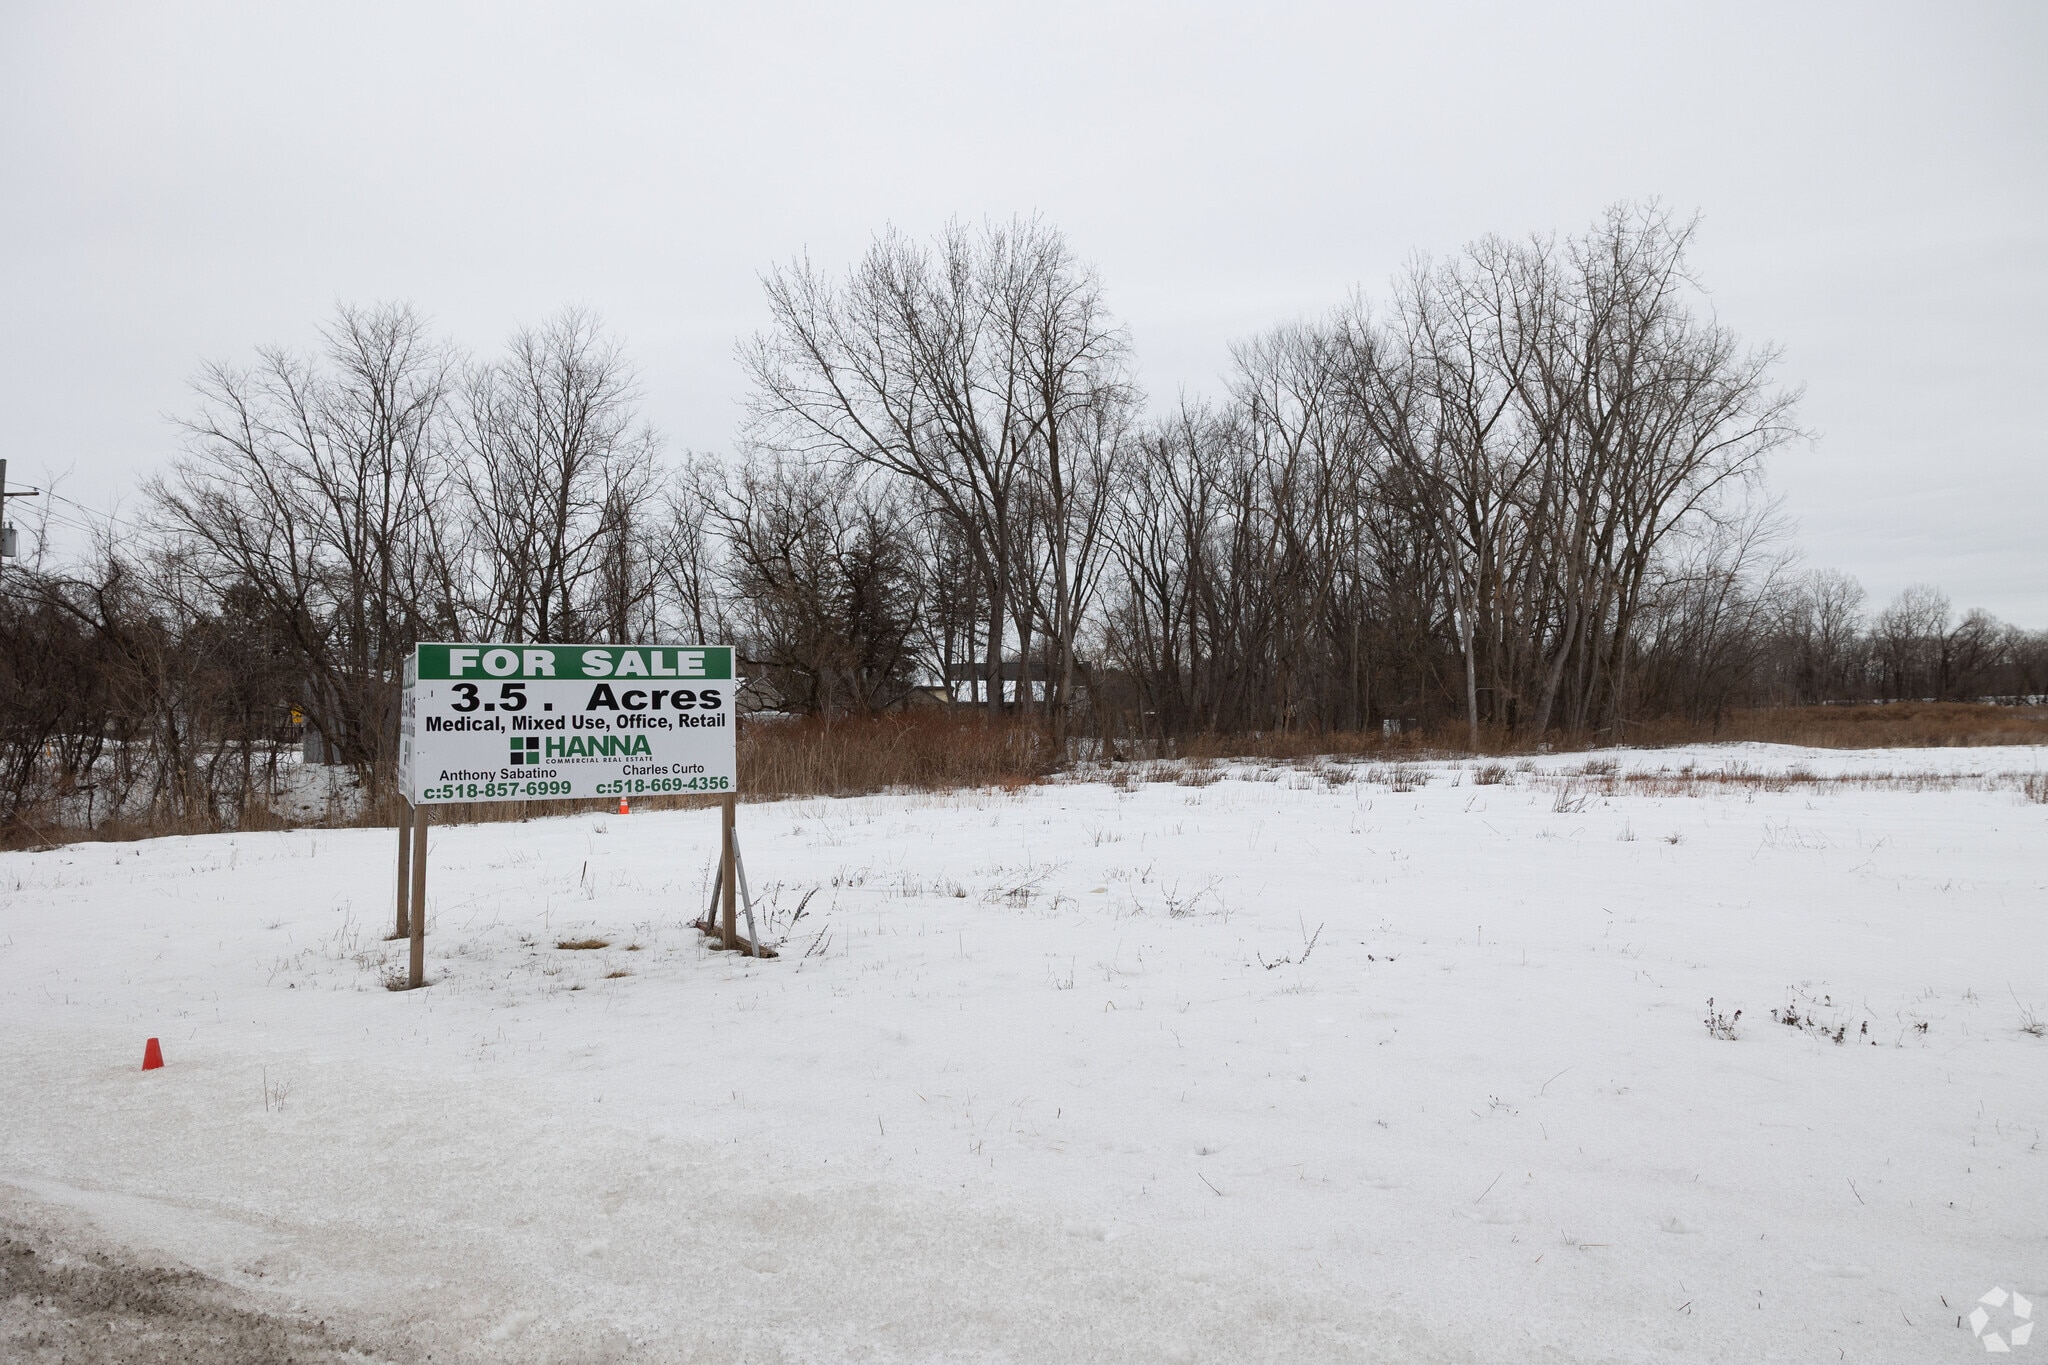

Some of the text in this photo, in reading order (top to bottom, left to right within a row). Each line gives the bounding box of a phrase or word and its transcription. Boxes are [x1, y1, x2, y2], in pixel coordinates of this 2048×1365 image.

[449, 648, 556, 677] FOR
[581, 649, 706, 677] SALE
[450, 683, 528, 712] 3.5
[585, 683, 722, 711] Acres
[426, 716, 506, 734] Medical,
[512, 715, 565, 730] Mixed
[572, 714, 610, 732] Use,
[616, 714, 673, 731] Office,
[678, 713, 726, 728] Retail
[545, 734, 652, 758] HANNA
[439, 768, 557, 782] Anthony Sabatino
[622, 763, 705, 775] Charles Curto
[423, 780, 572, 799] c:518-857-6999
[595, 776, 729, 794] c:518-669-4356
